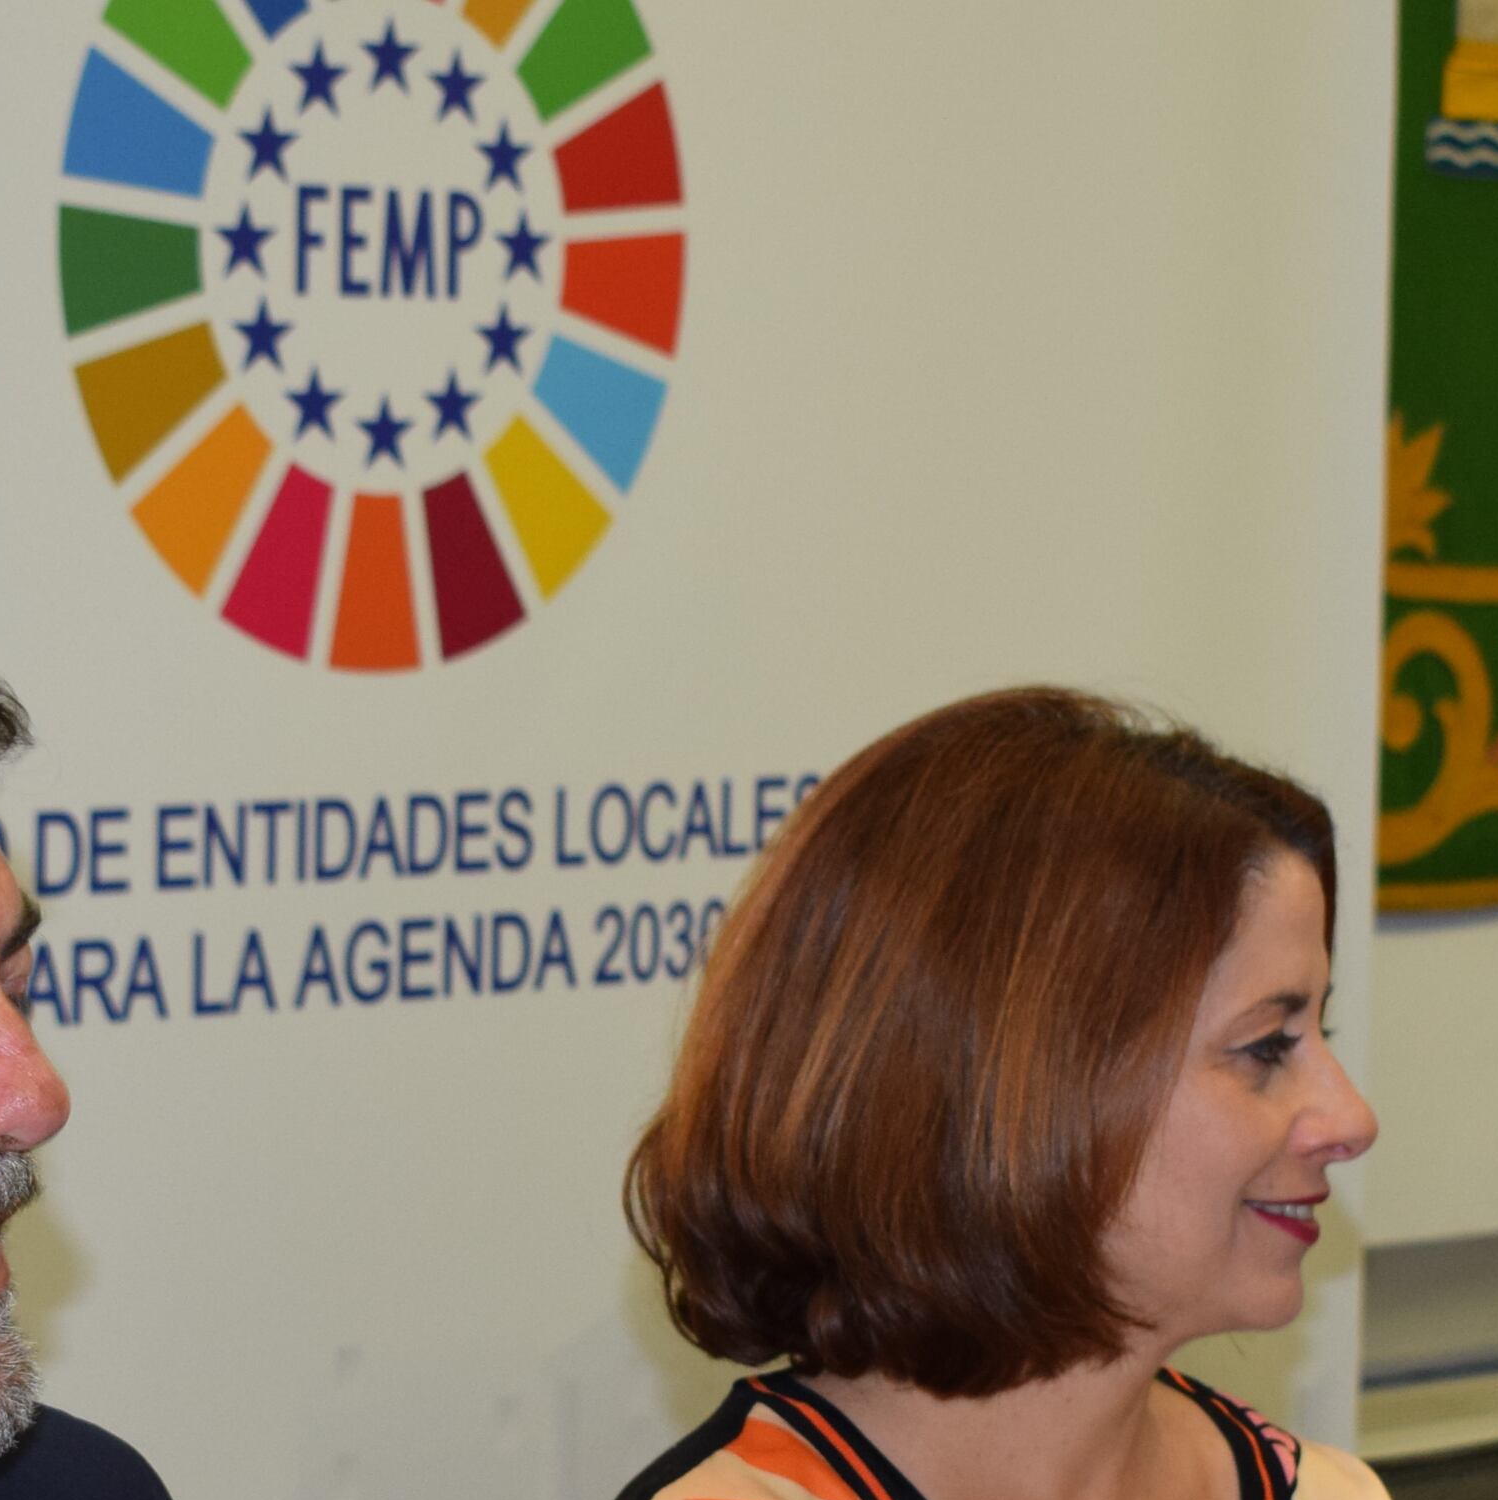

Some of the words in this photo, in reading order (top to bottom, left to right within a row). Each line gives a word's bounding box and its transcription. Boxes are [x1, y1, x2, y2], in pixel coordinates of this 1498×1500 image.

[293, 184, 485, 301] FEMP
[36, 809, 131, 896] DE
[155, 790, 533, 892] ENTIDADES
[27, 933, 169, 1027] ARA
[193, 928, 279, 1016] LA
[294, 911, 576, 1011] AGENDA
